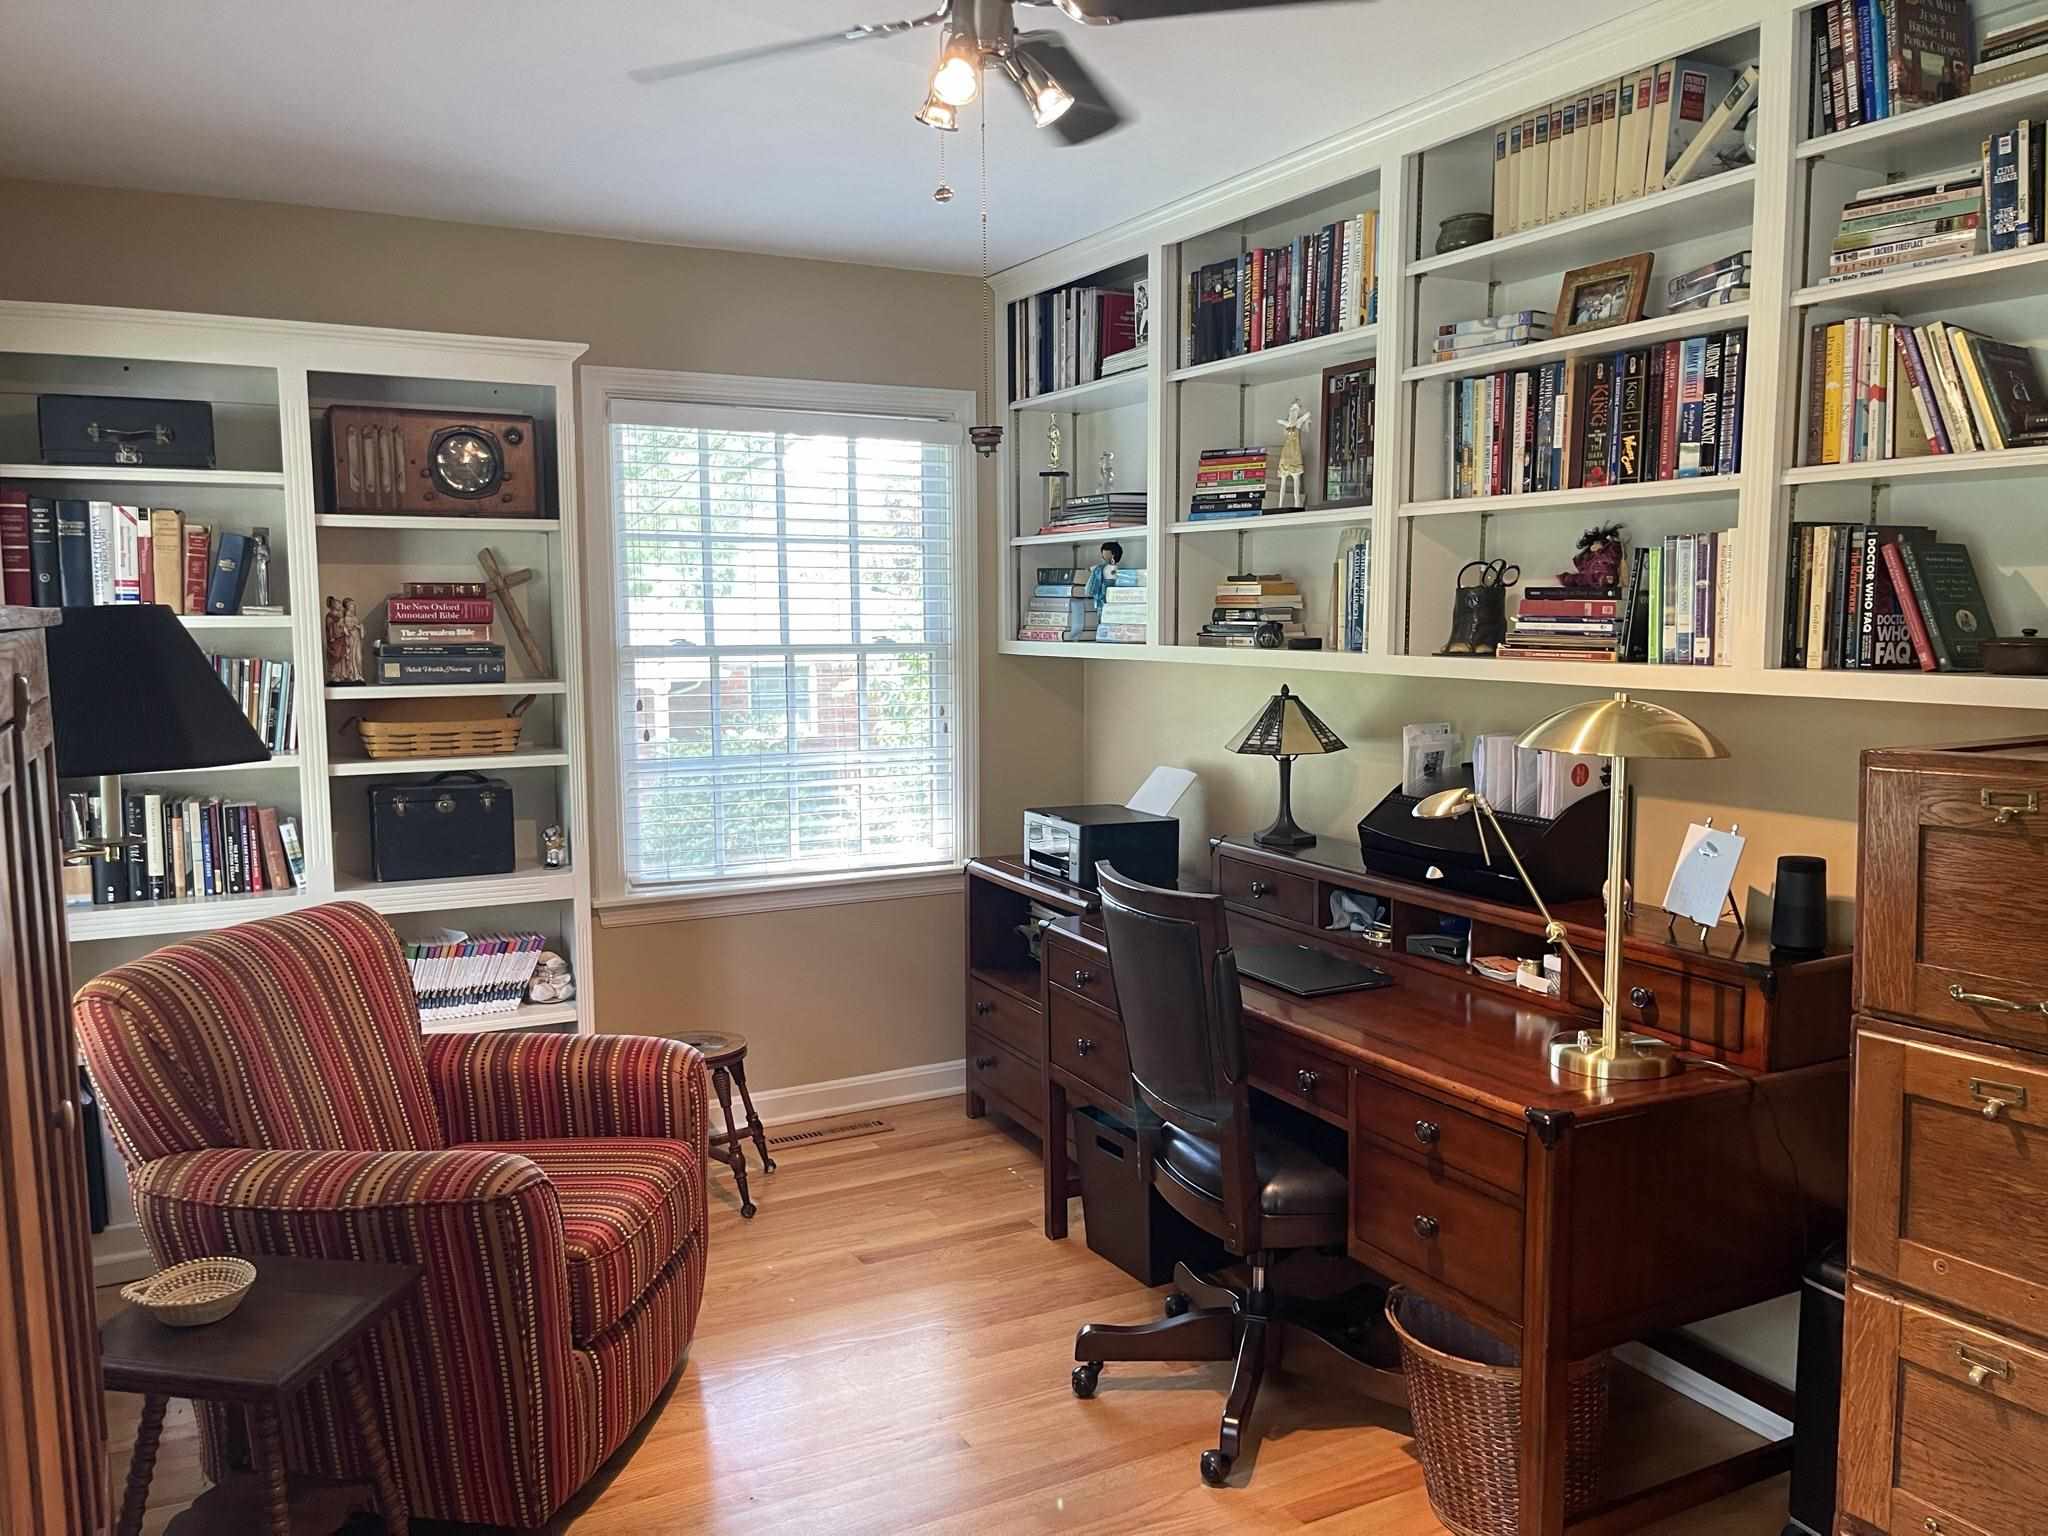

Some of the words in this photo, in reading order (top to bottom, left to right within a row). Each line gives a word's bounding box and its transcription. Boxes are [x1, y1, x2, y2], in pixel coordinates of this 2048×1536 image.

[1704, 343, 1721, 378] MIDNIGHT
[1590, 383, 1609, 427] KING
[1865, 538, 1876, 580] DOCTOR
[394, 602, 412, 611] The
[412, 603, 430, 611] New
[431, 602, 461, 611] Oxford
[1864, 582, 1874, 610] WHO
[394, 611, 438, 620] Annotated
[439, 611, 460, 620] Bible
[1863, 612, 1873, 633] FAQ
[1877, 614, 1905, 625] DOCTO
[400, 629, 416, 637] The
[417, 628, 455, 638] Jerusalem
[1877, 625, 1911, 642] WHO
[1875, 641, 1911, 665] FAQ
